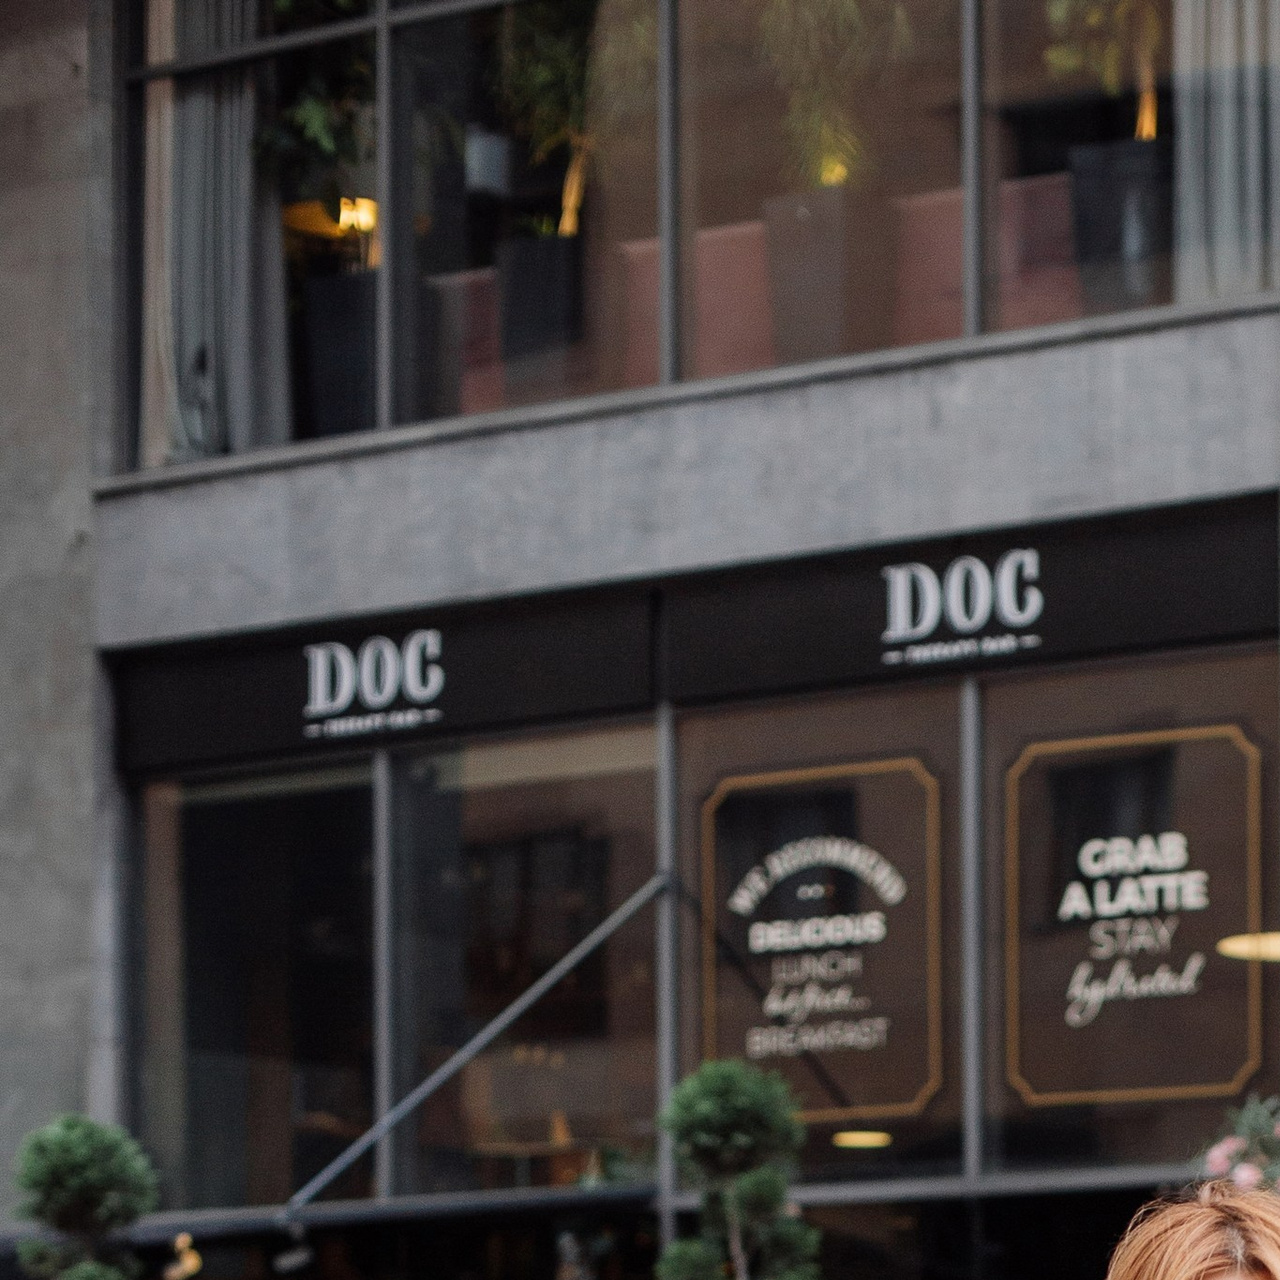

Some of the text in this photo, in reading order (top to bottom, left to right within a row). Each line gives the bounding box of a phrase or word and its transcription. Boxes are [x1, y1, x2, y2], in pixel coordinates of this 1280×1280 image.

[880, 547, 1044, 642] DOC
[303, 628, 445, 718] DOC
[1057, 870, 1210, 922] A LATTE
[1088, 913, 1180, 960] STAY
